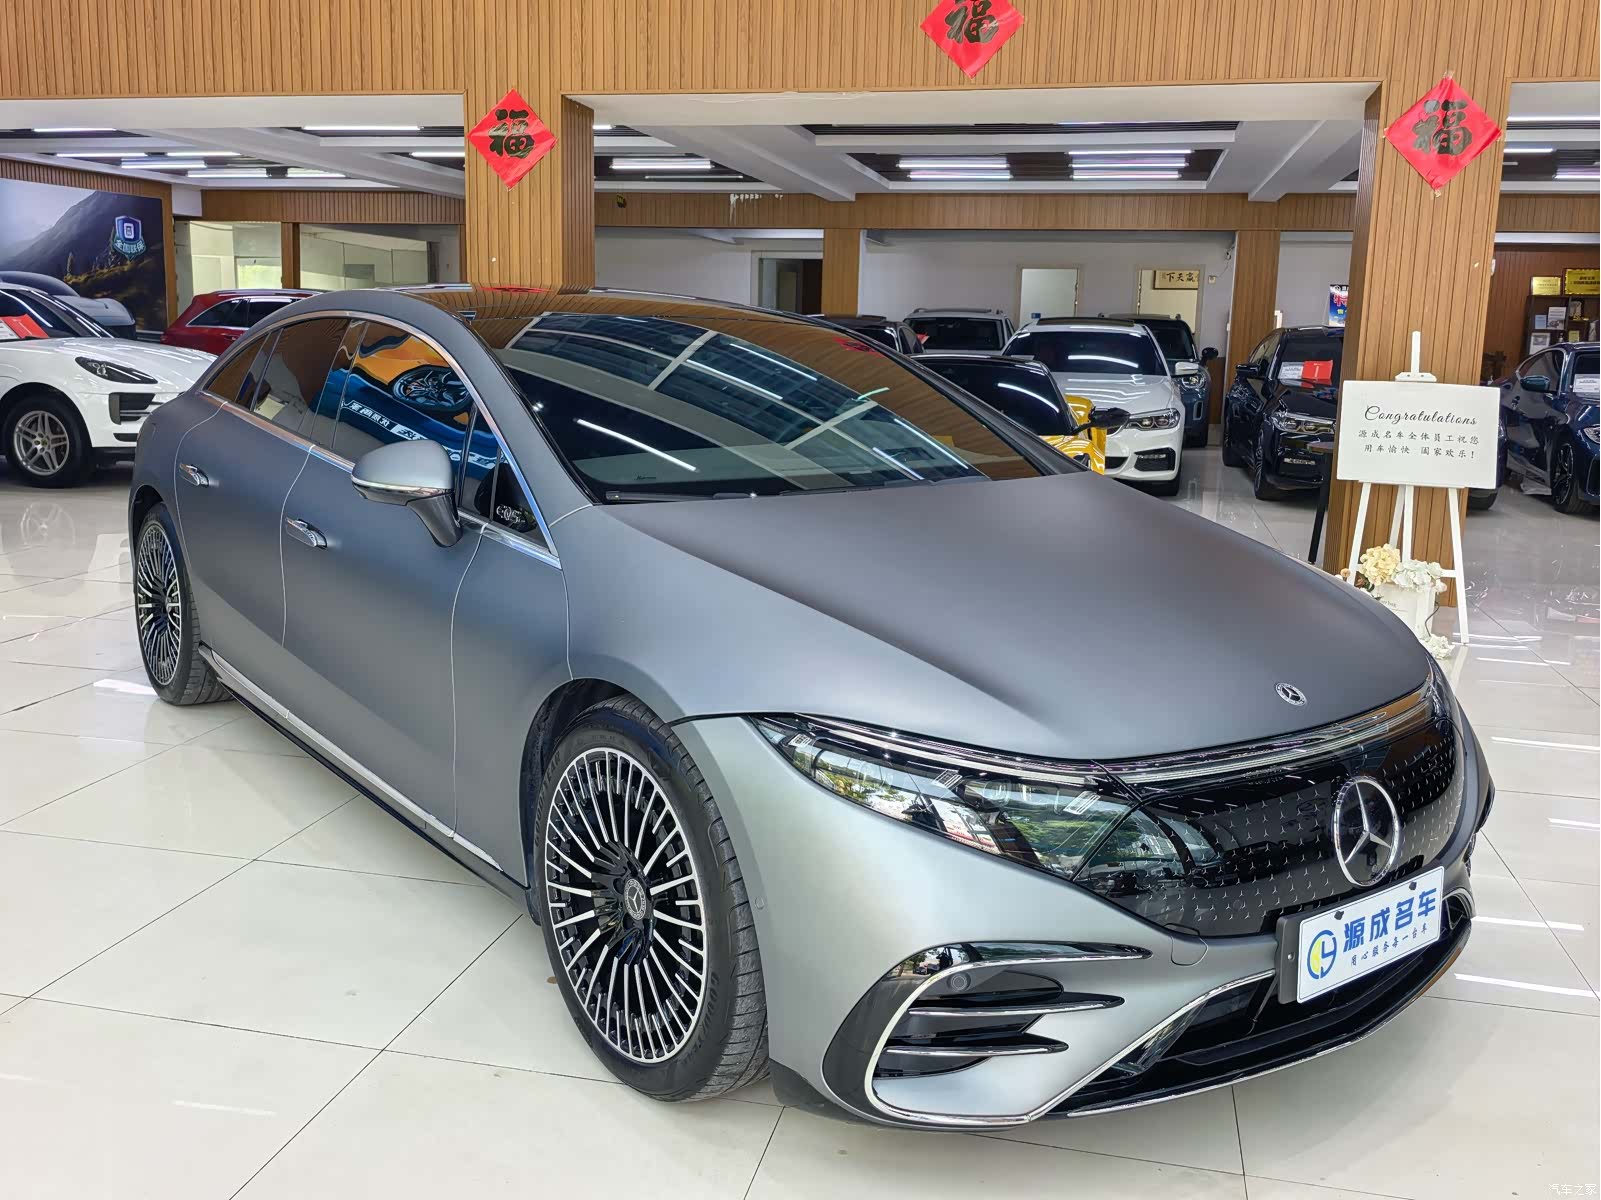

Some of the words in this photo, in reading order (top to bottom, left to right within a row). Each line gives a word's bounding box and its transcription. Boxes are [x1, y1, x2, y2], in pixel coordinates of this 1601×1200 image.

[488, 109, 535, 158] 福
[1412, 99, 1473, 155] 福
[1364, 405, 1478, 425] Congratulations
[1342, 887, 1438, 953] 源成名车
